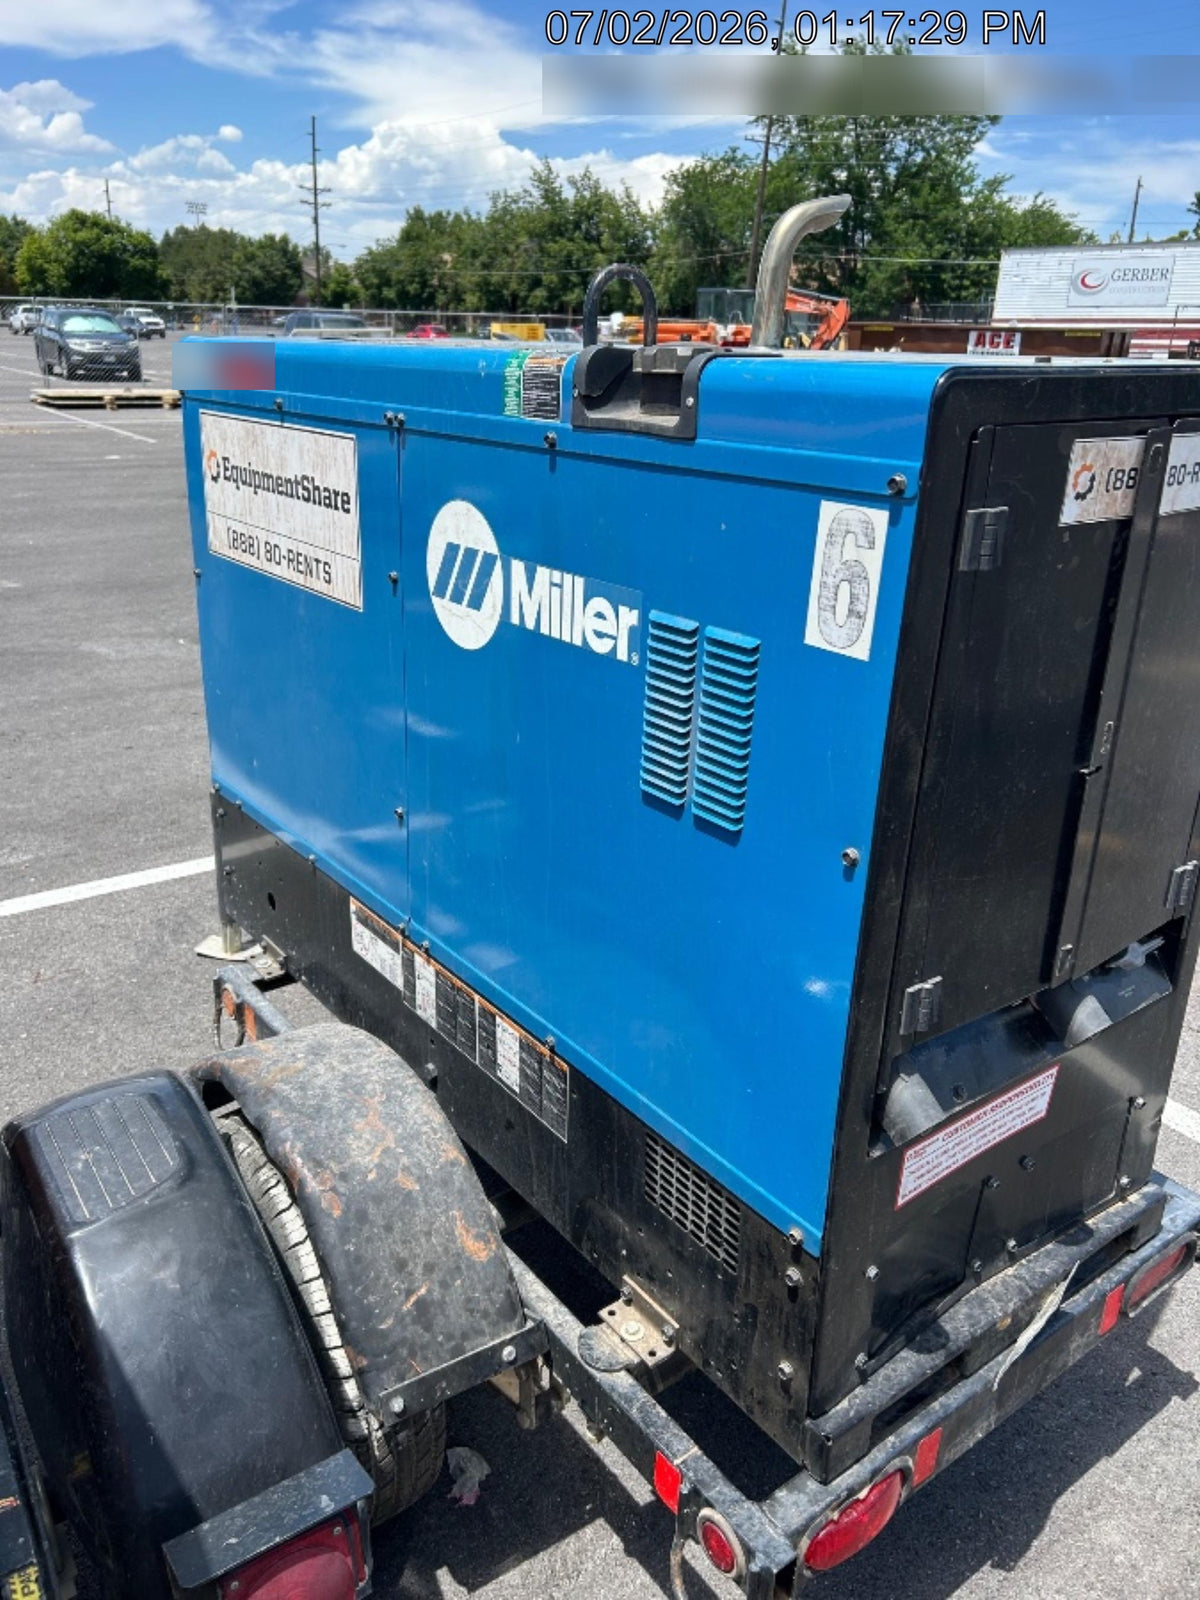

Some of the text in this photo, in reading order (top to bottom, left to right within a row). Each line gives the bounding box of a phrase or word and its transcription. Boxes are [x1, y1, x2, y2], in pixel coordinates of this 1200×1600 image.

[1111, 268, 1169, 282] GERBER
[974, 330, 1016, 349] ACE
[221, 456, 351, 515] EquipmentShare
[226, 526, 332, 585] (888) 80-RENTS
[817, 508, 875, 649] 6
[510, 557, 640, 662] Miller
